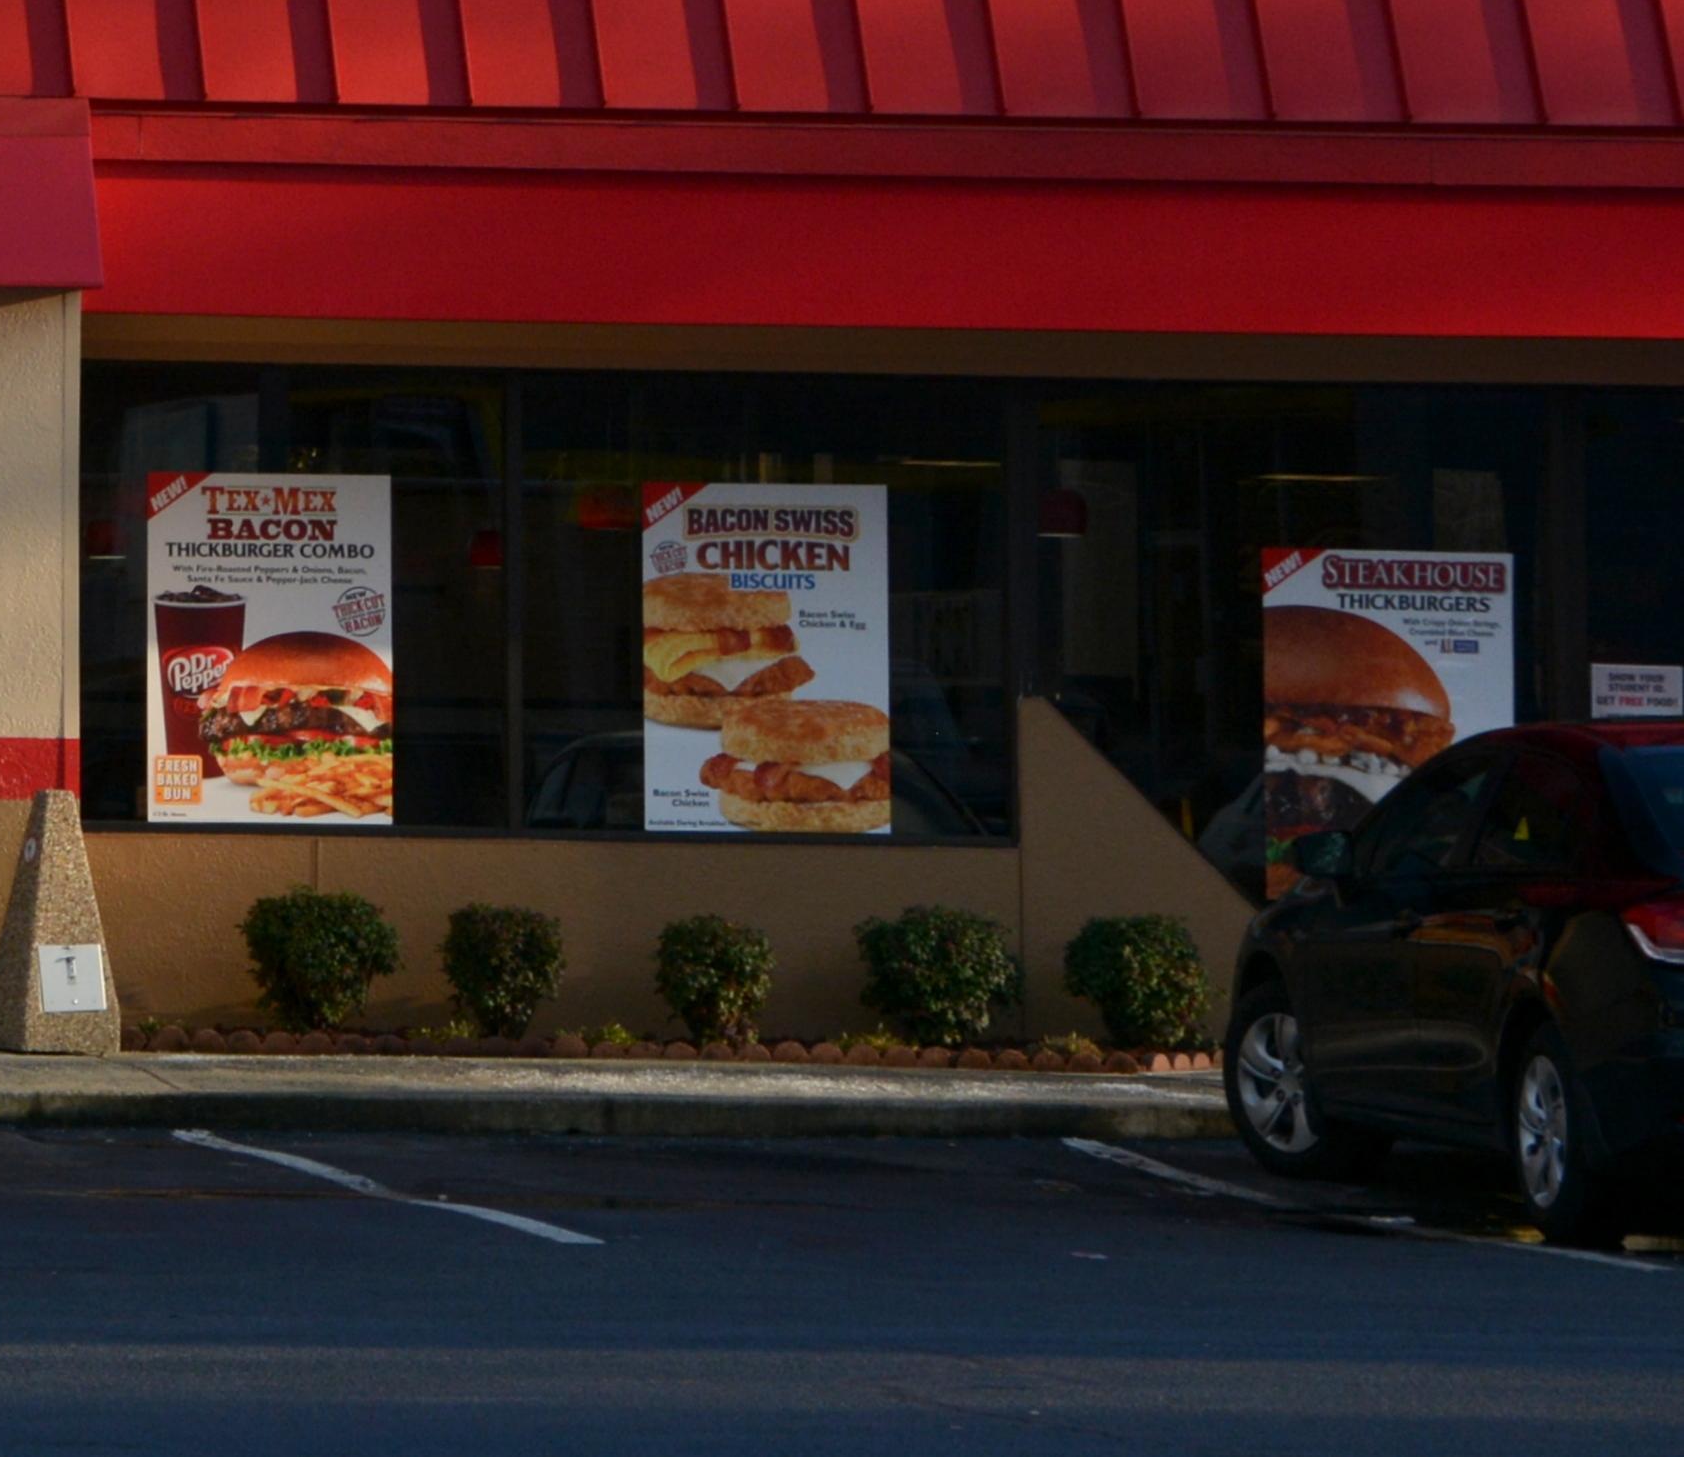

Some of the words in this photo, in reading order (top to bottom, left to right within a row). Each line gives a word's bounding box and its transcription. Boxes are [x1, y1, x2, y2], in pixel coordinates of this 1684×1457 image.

[149, 475, 188, 512] NEW!
[645, 487, 685, 524] NEW!
[206, 518, 338, 541] BACON
[687, 508, 769, 536] BACON
[774, 508, 854, 537] SWISS
[165, 542, 293, 559] THICKBURGER
[299, 543, 375, 559] COMBO
[696, 540, 851, 572] CHICKEN
[172, 564, 193, 574] With
[1264, 550, 1303, 588] NEW!
[1323, 557, 1502, 588] STEAKHOUSE
[731, 573, 816, 591] BISCUITS
[1337, 593, 1491, 613] THICKBURGERS
[344, 613, 383, 633] BACON
[798, 610, 829, 620] Bacon
[830, 610, 856, 620] Swiss
[798, 619, 838, 630] Chicken
[848, 620, 867, 632] Egg
[189, 652, 217, 671] Dr
[1618, 695, 1644, 707] FREE
[157, 759, 198, 773] FRESH
[156, 773, 199, 787] BAKED
[163, 787, 192, 801] BUN
[652, 789, 683, 798] Bacon
[684, 789, 710, 798] Swiss
[672, 798, 711, 808] Chicken
